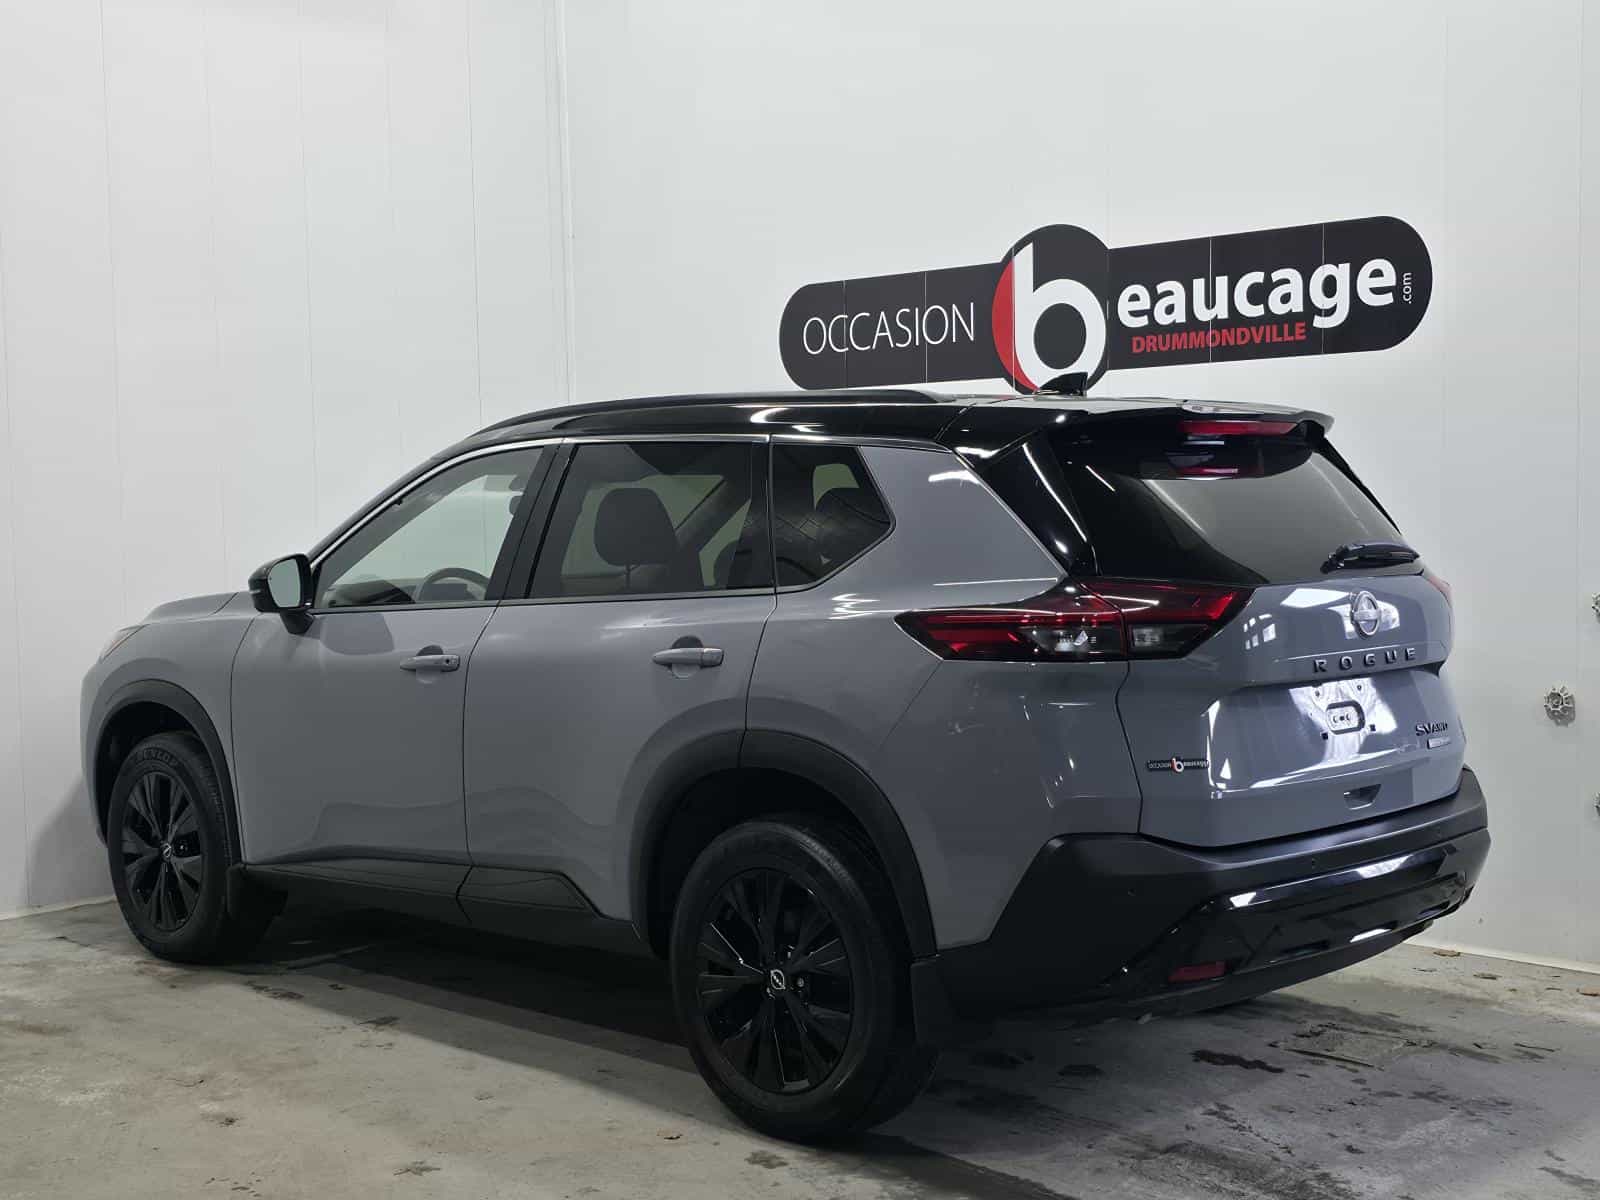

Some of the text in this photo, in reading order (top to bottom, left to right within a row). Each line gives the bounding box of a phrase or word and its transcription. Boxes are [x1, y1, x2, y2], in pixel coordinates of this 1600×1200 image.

[803, 302, 974, 354] OCCASION
[1402, 271, 1412, 304] .com
[1131, 322, 1307, 353] DRUMMONDVILLE
[1313, 647, 1416, 672] ROGUE
